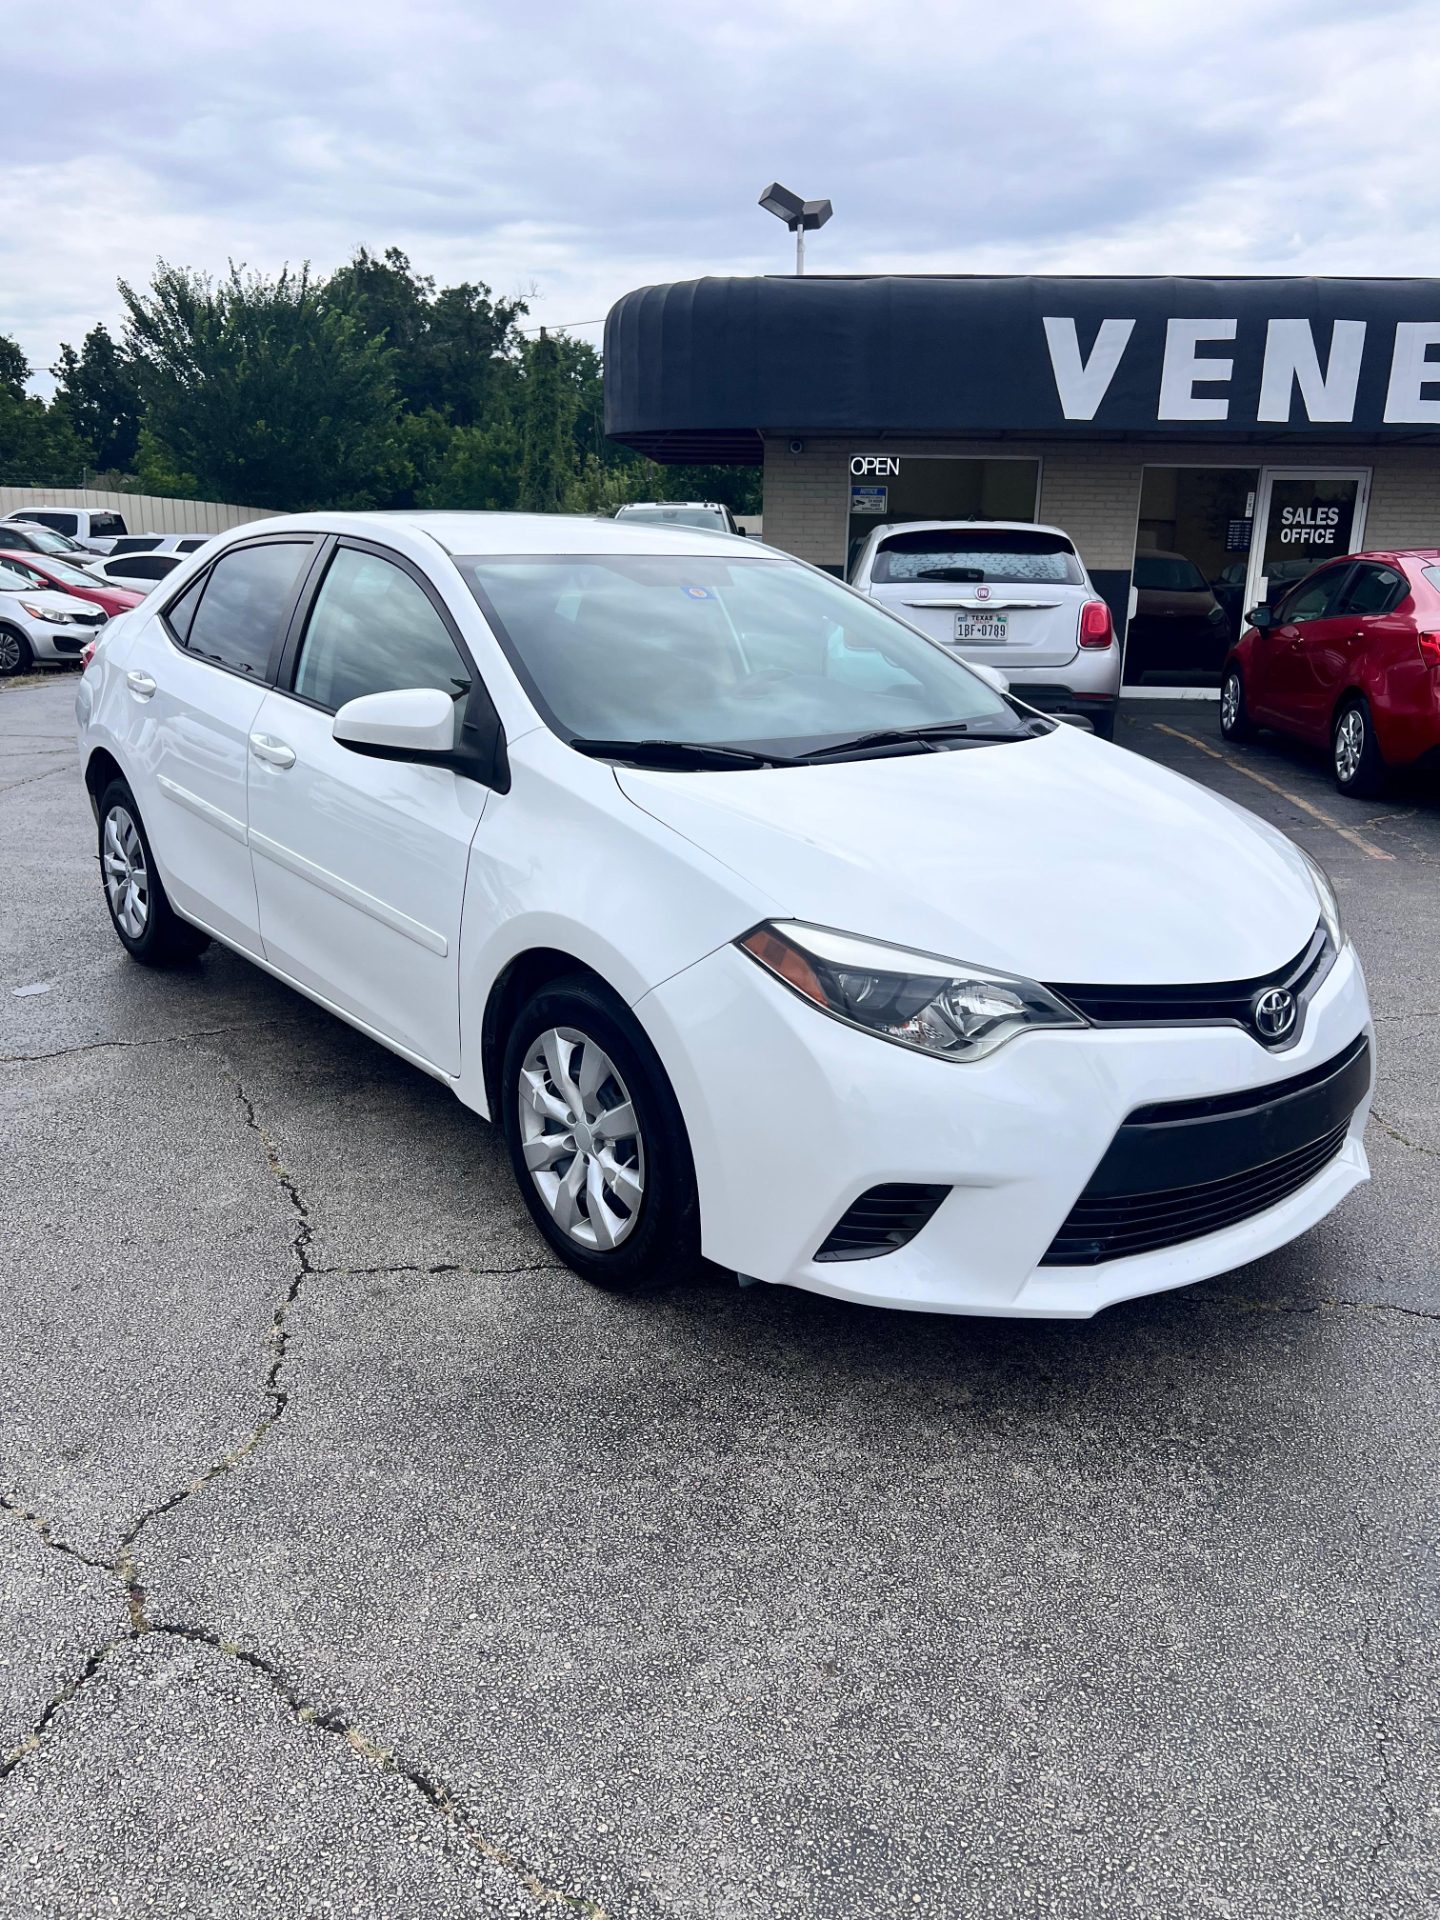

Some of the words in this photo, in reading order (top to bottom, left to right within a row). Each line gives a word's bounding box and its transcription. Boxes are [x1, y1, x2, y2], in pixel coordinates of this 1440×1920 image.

[1042, 317, 1440, 424] VENE
[850, 457, 900, 475] OPEN
[1281, 507, 1339, 526] SALES
[1280, 528, 1336, 544] OFFICE
